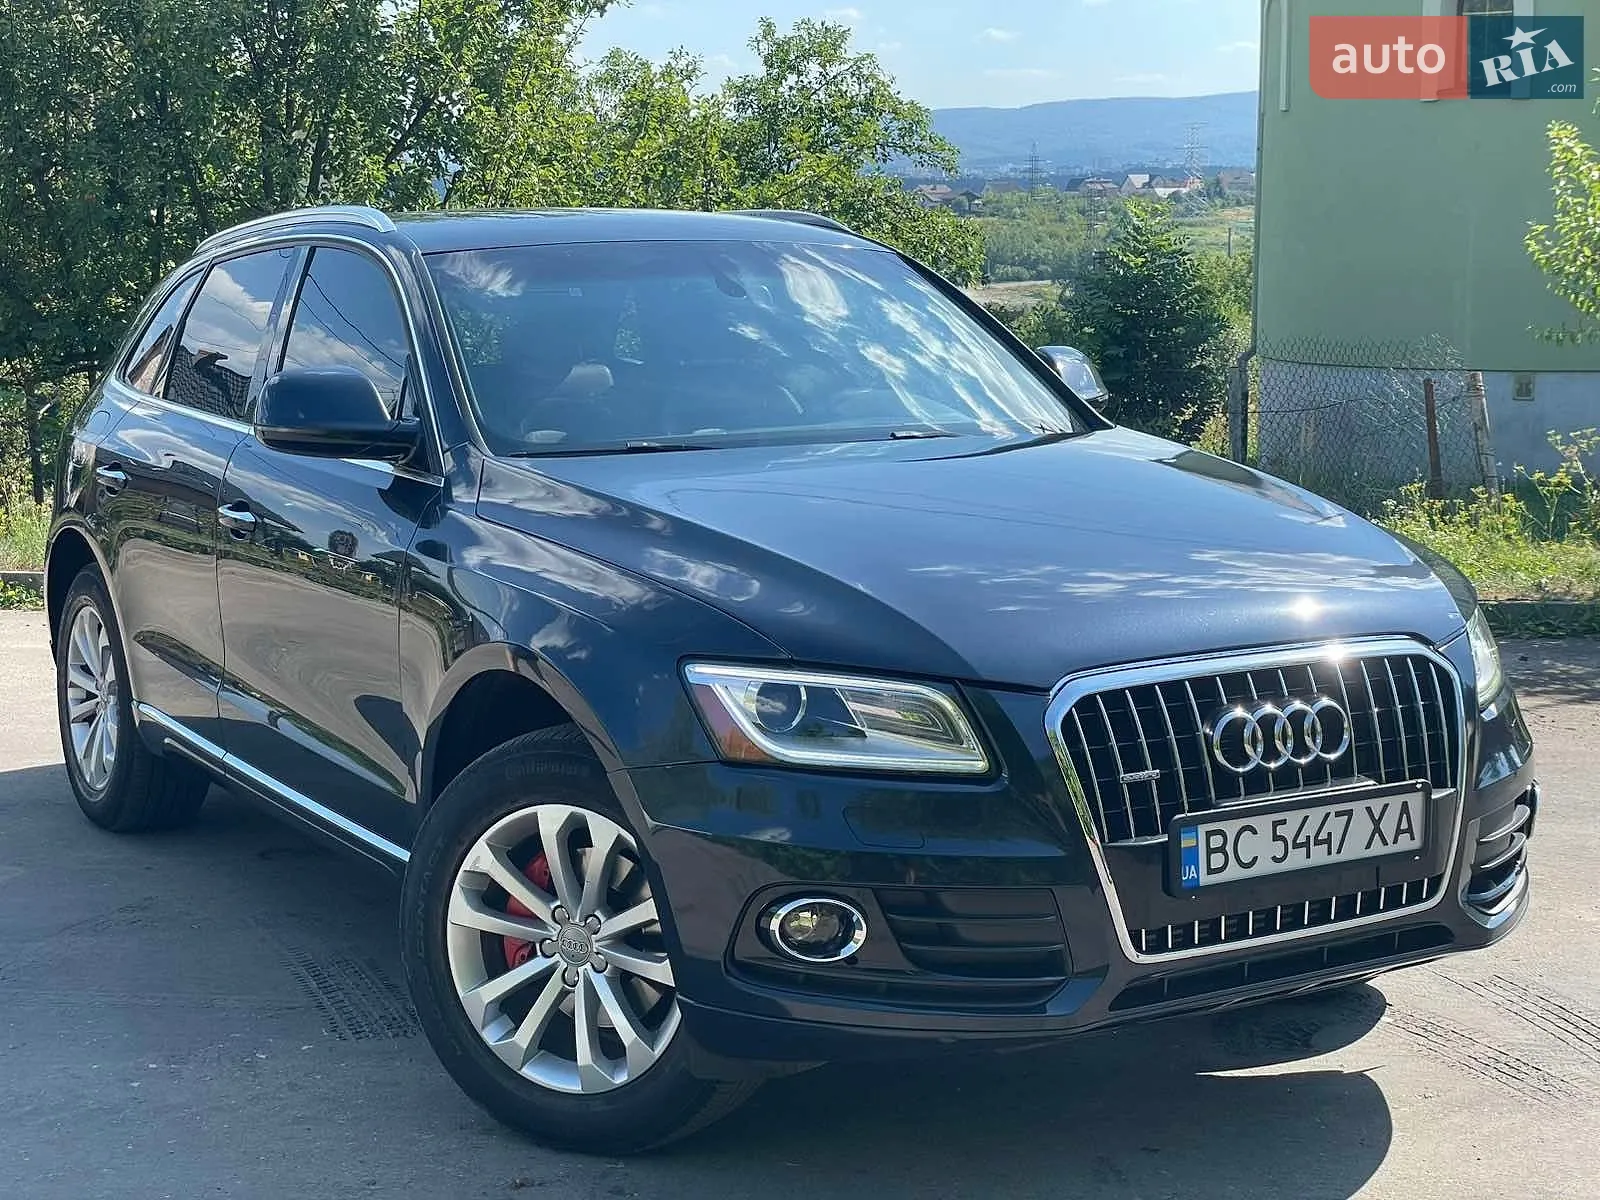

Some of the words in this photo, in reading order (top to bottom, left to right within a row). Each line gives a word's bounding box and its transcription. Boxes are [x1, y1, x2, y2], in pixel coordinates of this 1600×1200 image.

[1205, 825, 1259, 876] BC
[1271, 809, 1354, 864] 5447
[1364, 800, 1416, 850] XA
[1182, 865, 1198, 880] UA
